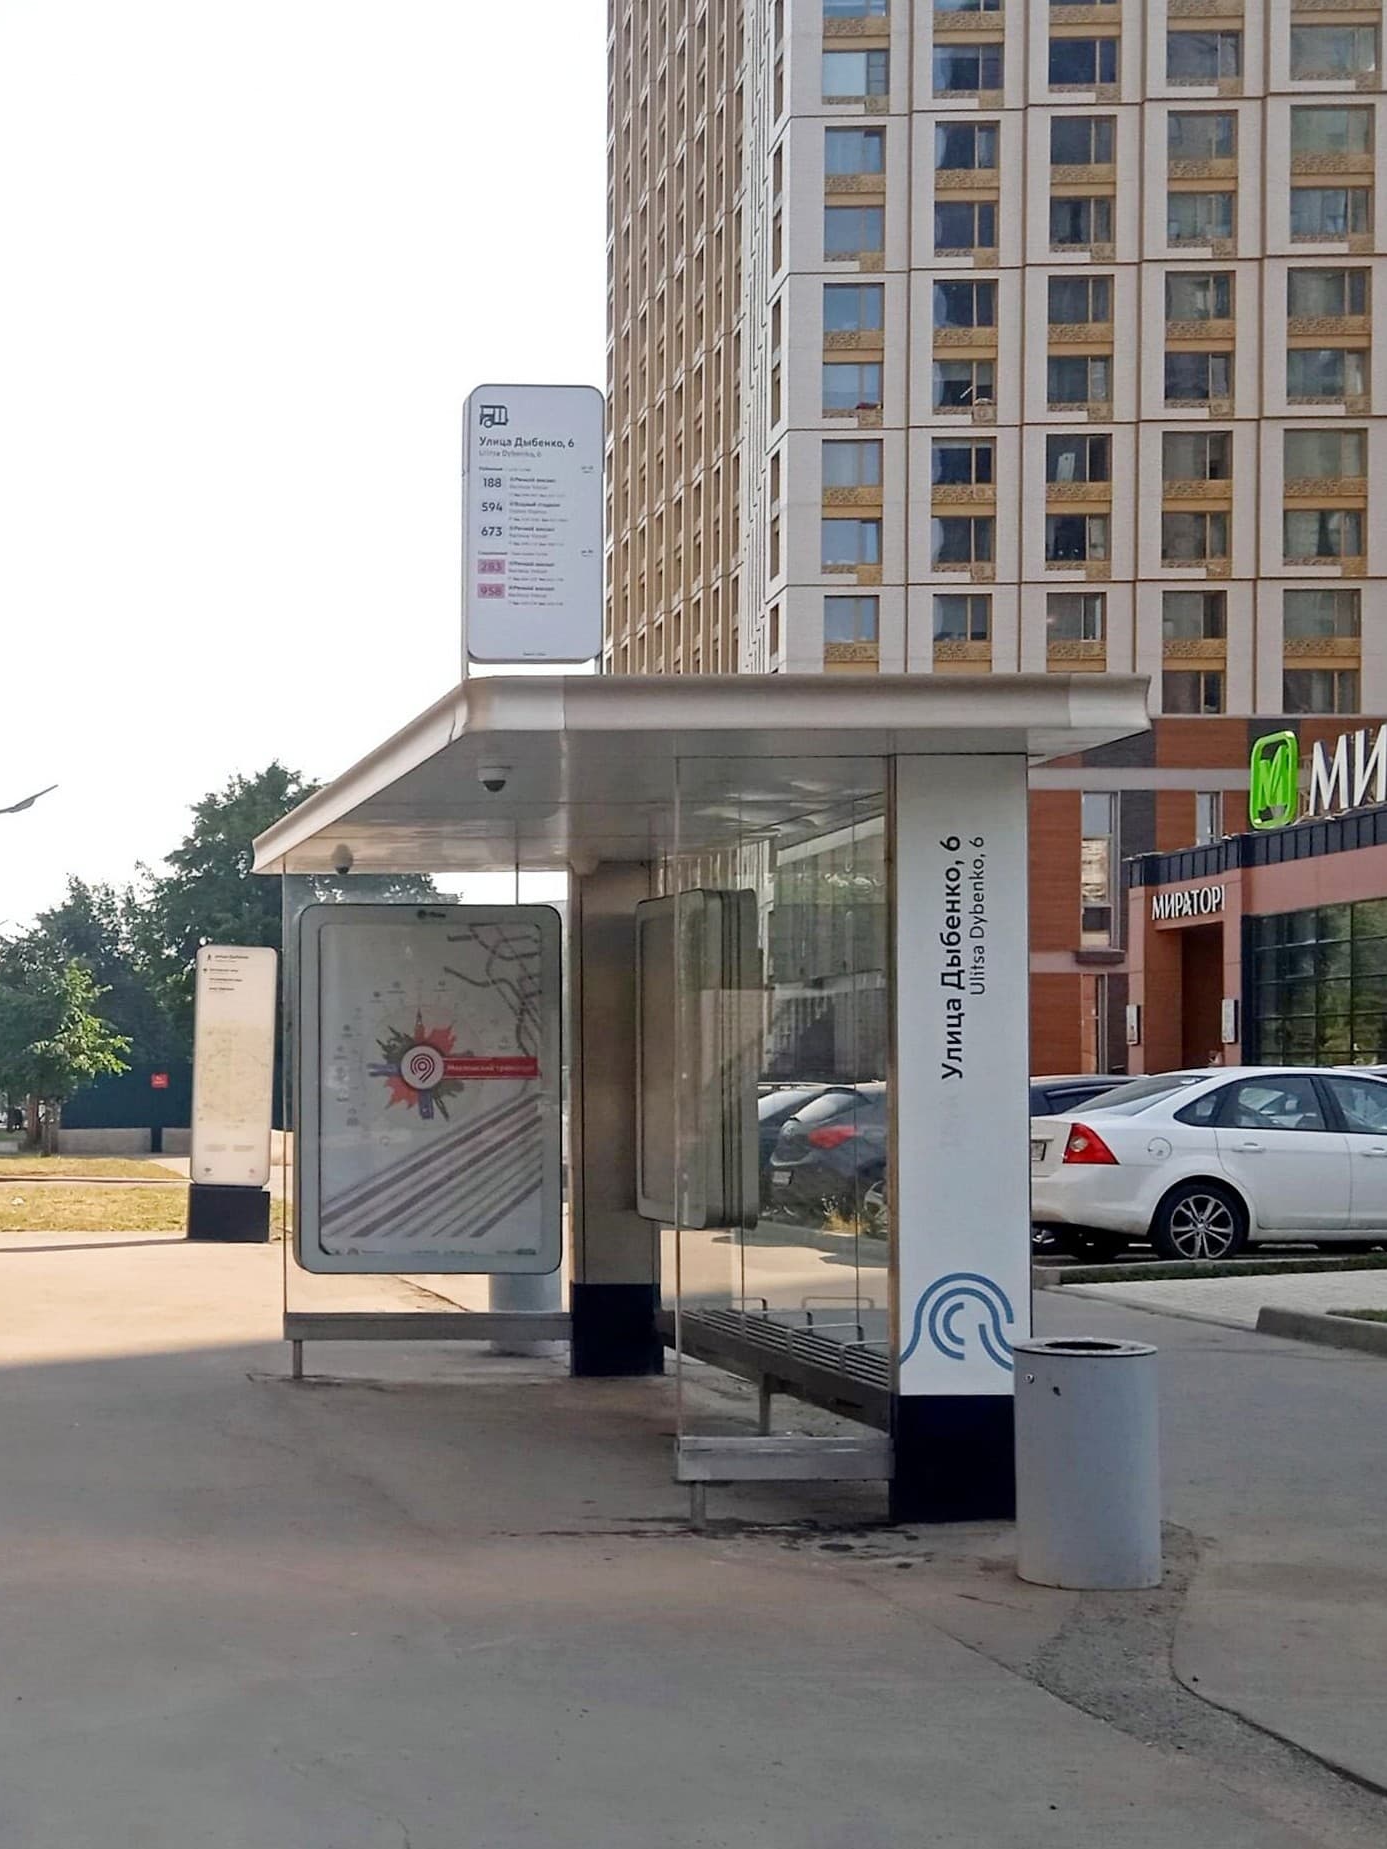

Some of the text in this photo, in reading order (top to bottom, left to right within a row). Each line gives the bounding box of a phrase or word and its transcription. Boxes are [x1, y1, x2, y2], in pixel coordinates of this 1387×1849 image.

[479, 436, 574, 449] Улица Дыбенко, 6
[483, 478, 502, 488] 188
[481, 502, 503, 512] 594
[481, 526, 503, 537] 673
[969, 836, 988, 995] Ulitsa Dybenko, 6
[940, 836, 965, 1080] Улица Дыбенко, 6
